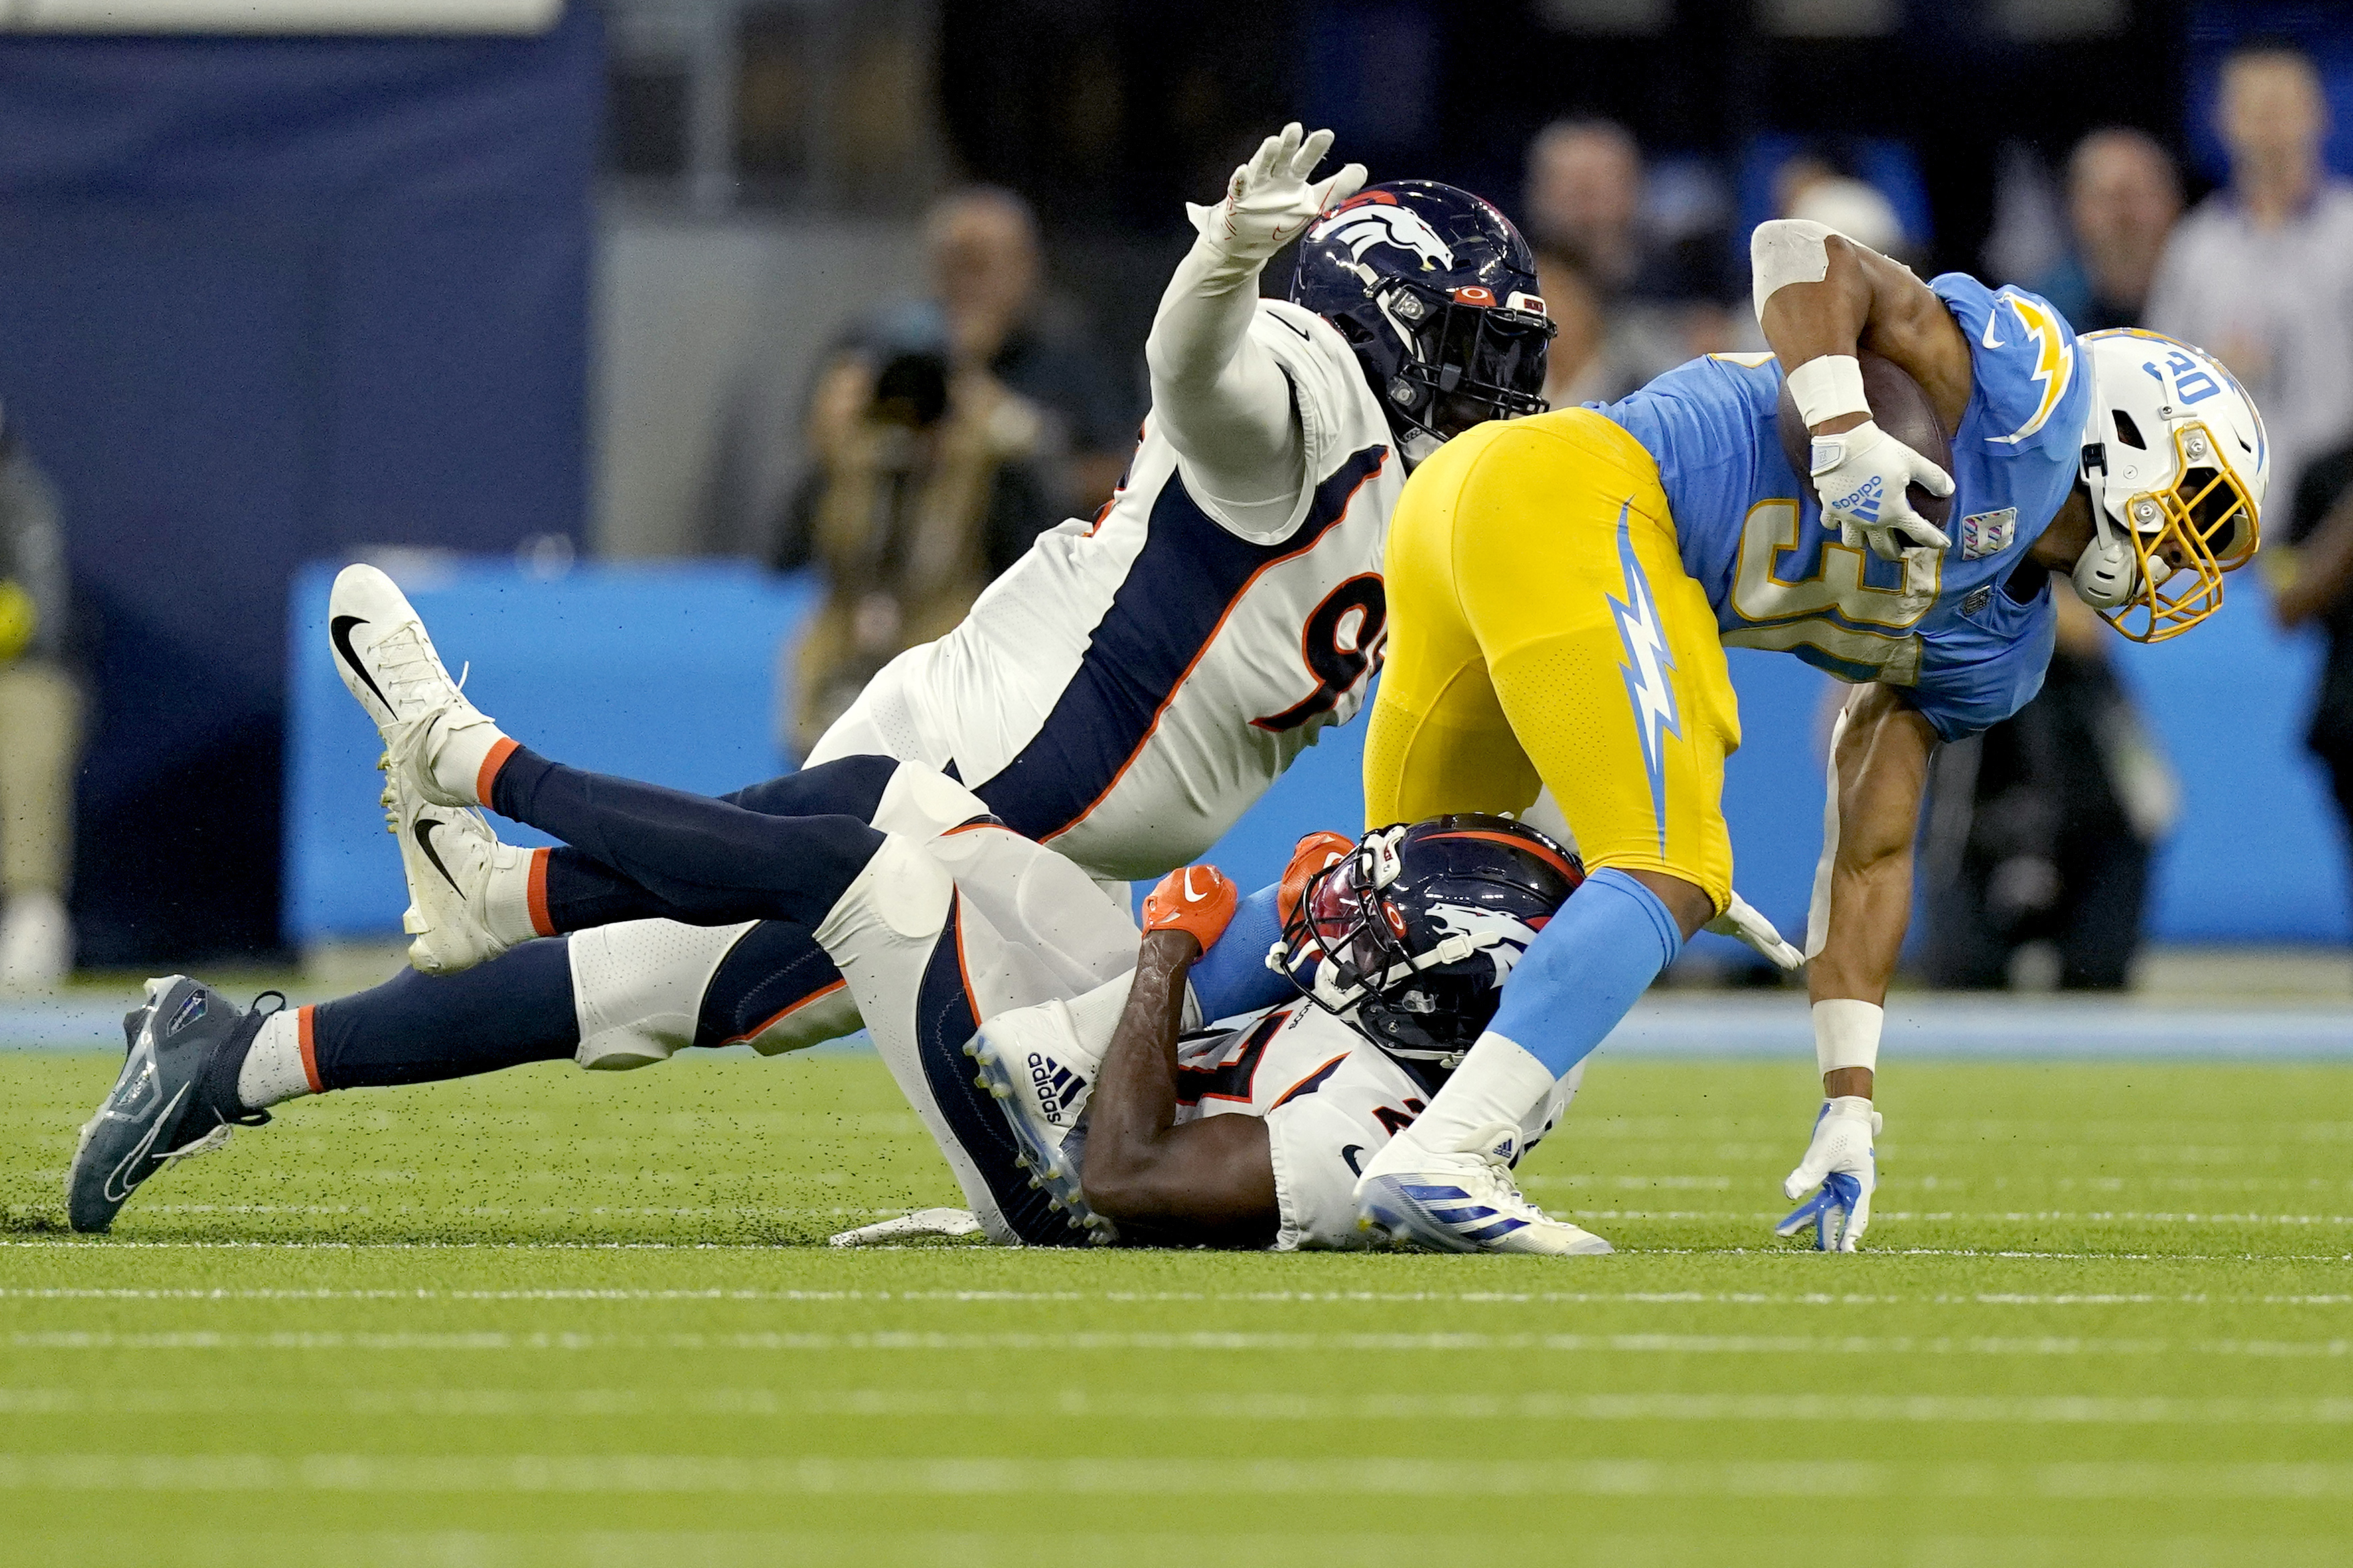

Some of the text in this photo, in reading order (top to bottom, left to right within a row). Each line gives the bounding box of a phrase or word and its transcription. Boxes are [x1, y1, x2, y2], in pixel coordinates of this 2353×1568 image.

[2142, 351, 2220, 405] 30
[1831, 476, 1882, 509] adidas
[1247, 571, 1388, 732] 9
[1027, 1052, 1061, 1123] adidas
